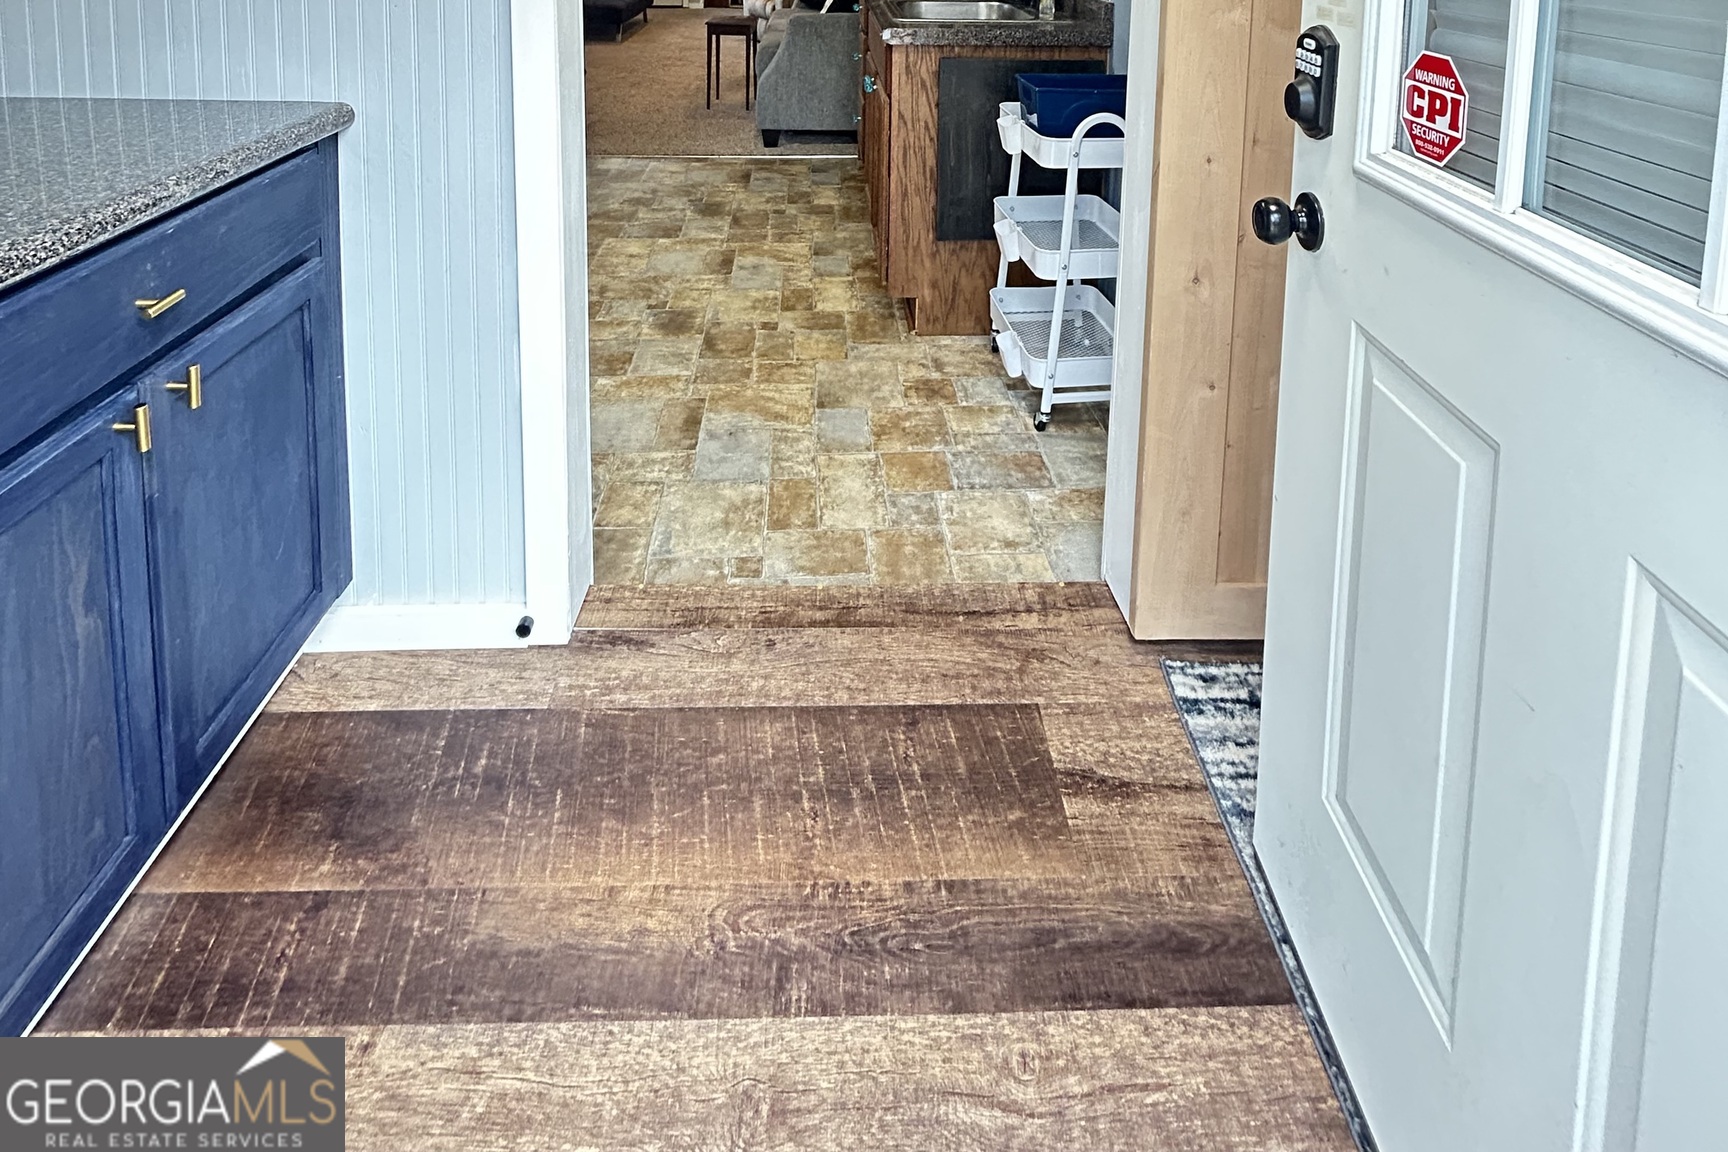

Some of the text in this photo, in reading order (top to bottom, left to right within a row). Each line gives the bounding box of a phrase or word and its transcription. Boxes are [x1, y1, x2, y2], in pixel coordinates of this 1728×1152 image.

[1415, 68, 1456, 91] WARNING
[1406, 84, 1462, 134] CPI
[1411, 123, 1450, 147] SECURITY
